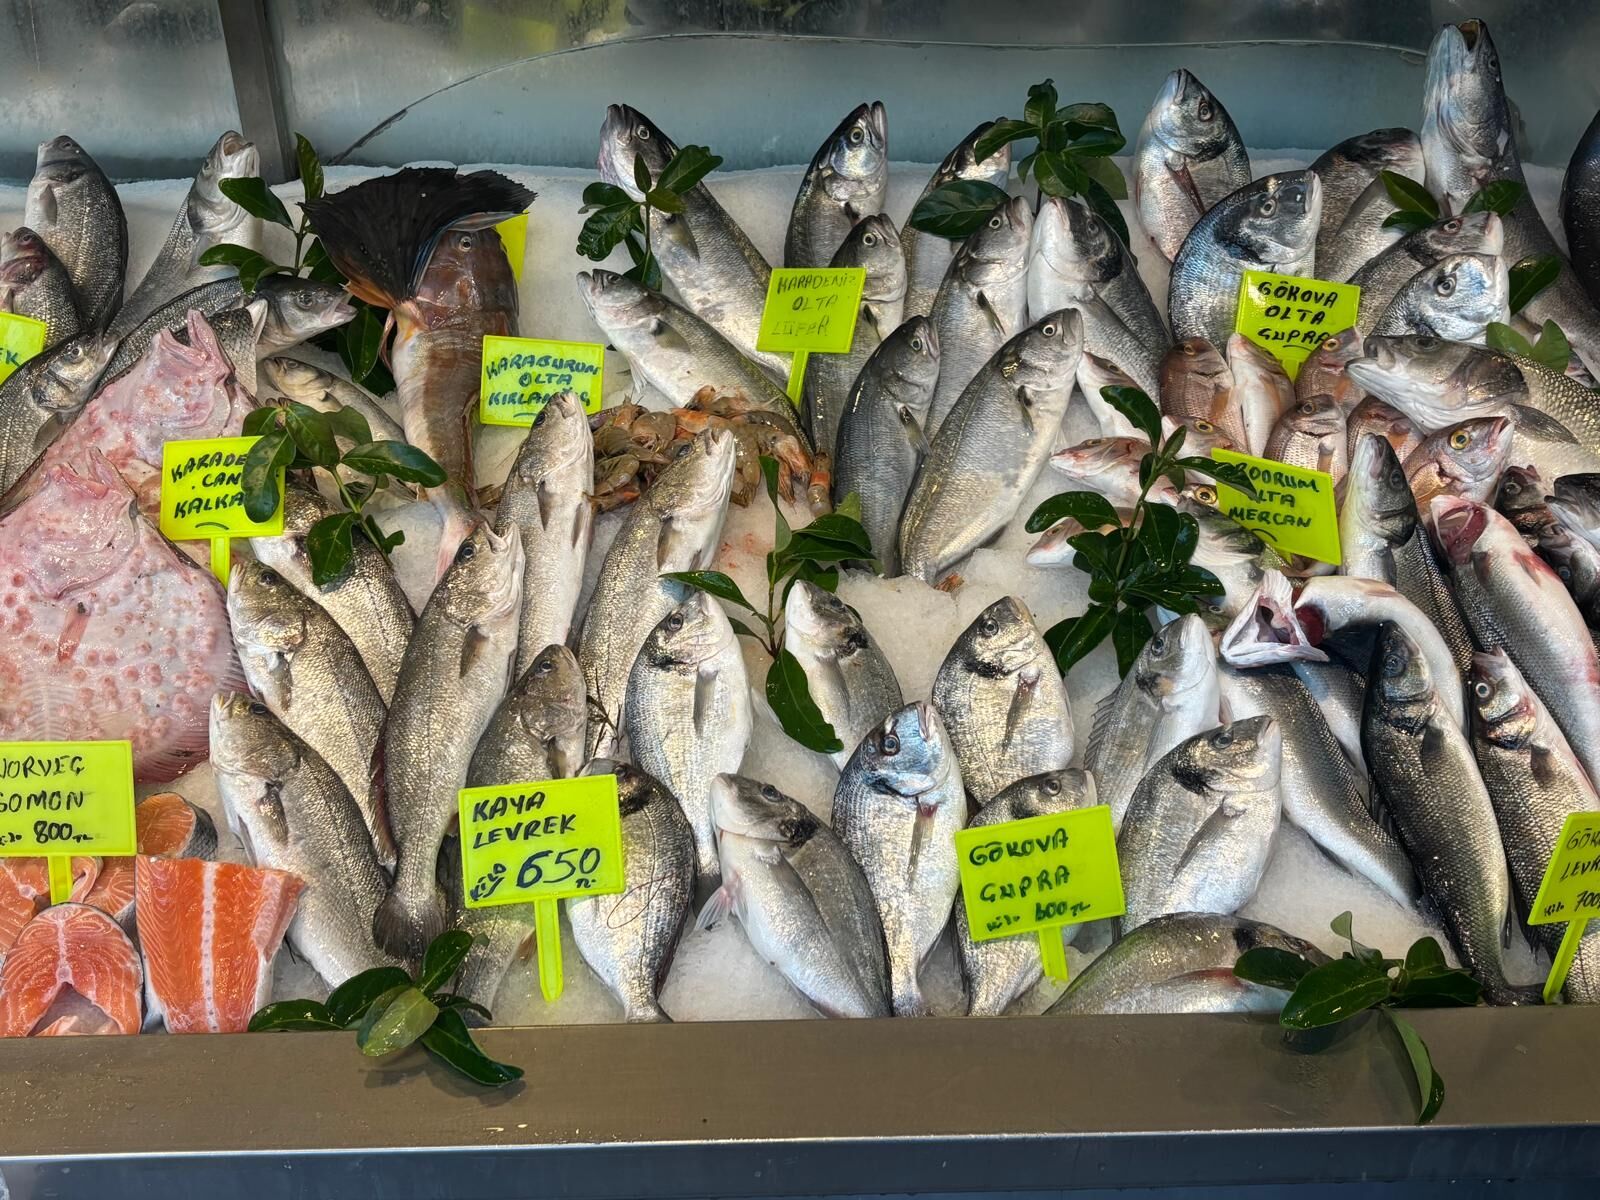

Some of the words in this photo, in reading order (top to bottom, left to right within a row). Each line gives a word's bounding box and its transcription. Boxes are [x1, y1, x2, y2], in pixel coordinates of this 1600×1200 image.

[792, 295, 838, 311] OLTA
[1258, 281, 1338, 308] GÖKOVA
[1265, 305, 1325, 325] OLTA
[519, 372, 572, 387] OLTA
[171, 452, 247, 483] KARADE
[174, 492, 245, 519] KALKA
[1258, 489, 1296, 508] LTA
[1228, 506, 1311, 528] MERCAN
[473, 791, 546, 823] KAYA
[473, 814, 576, 849] LEVREK
[969, 828, 1069, 866] GÖKOVA
[516, 848, 600, 888] 650
